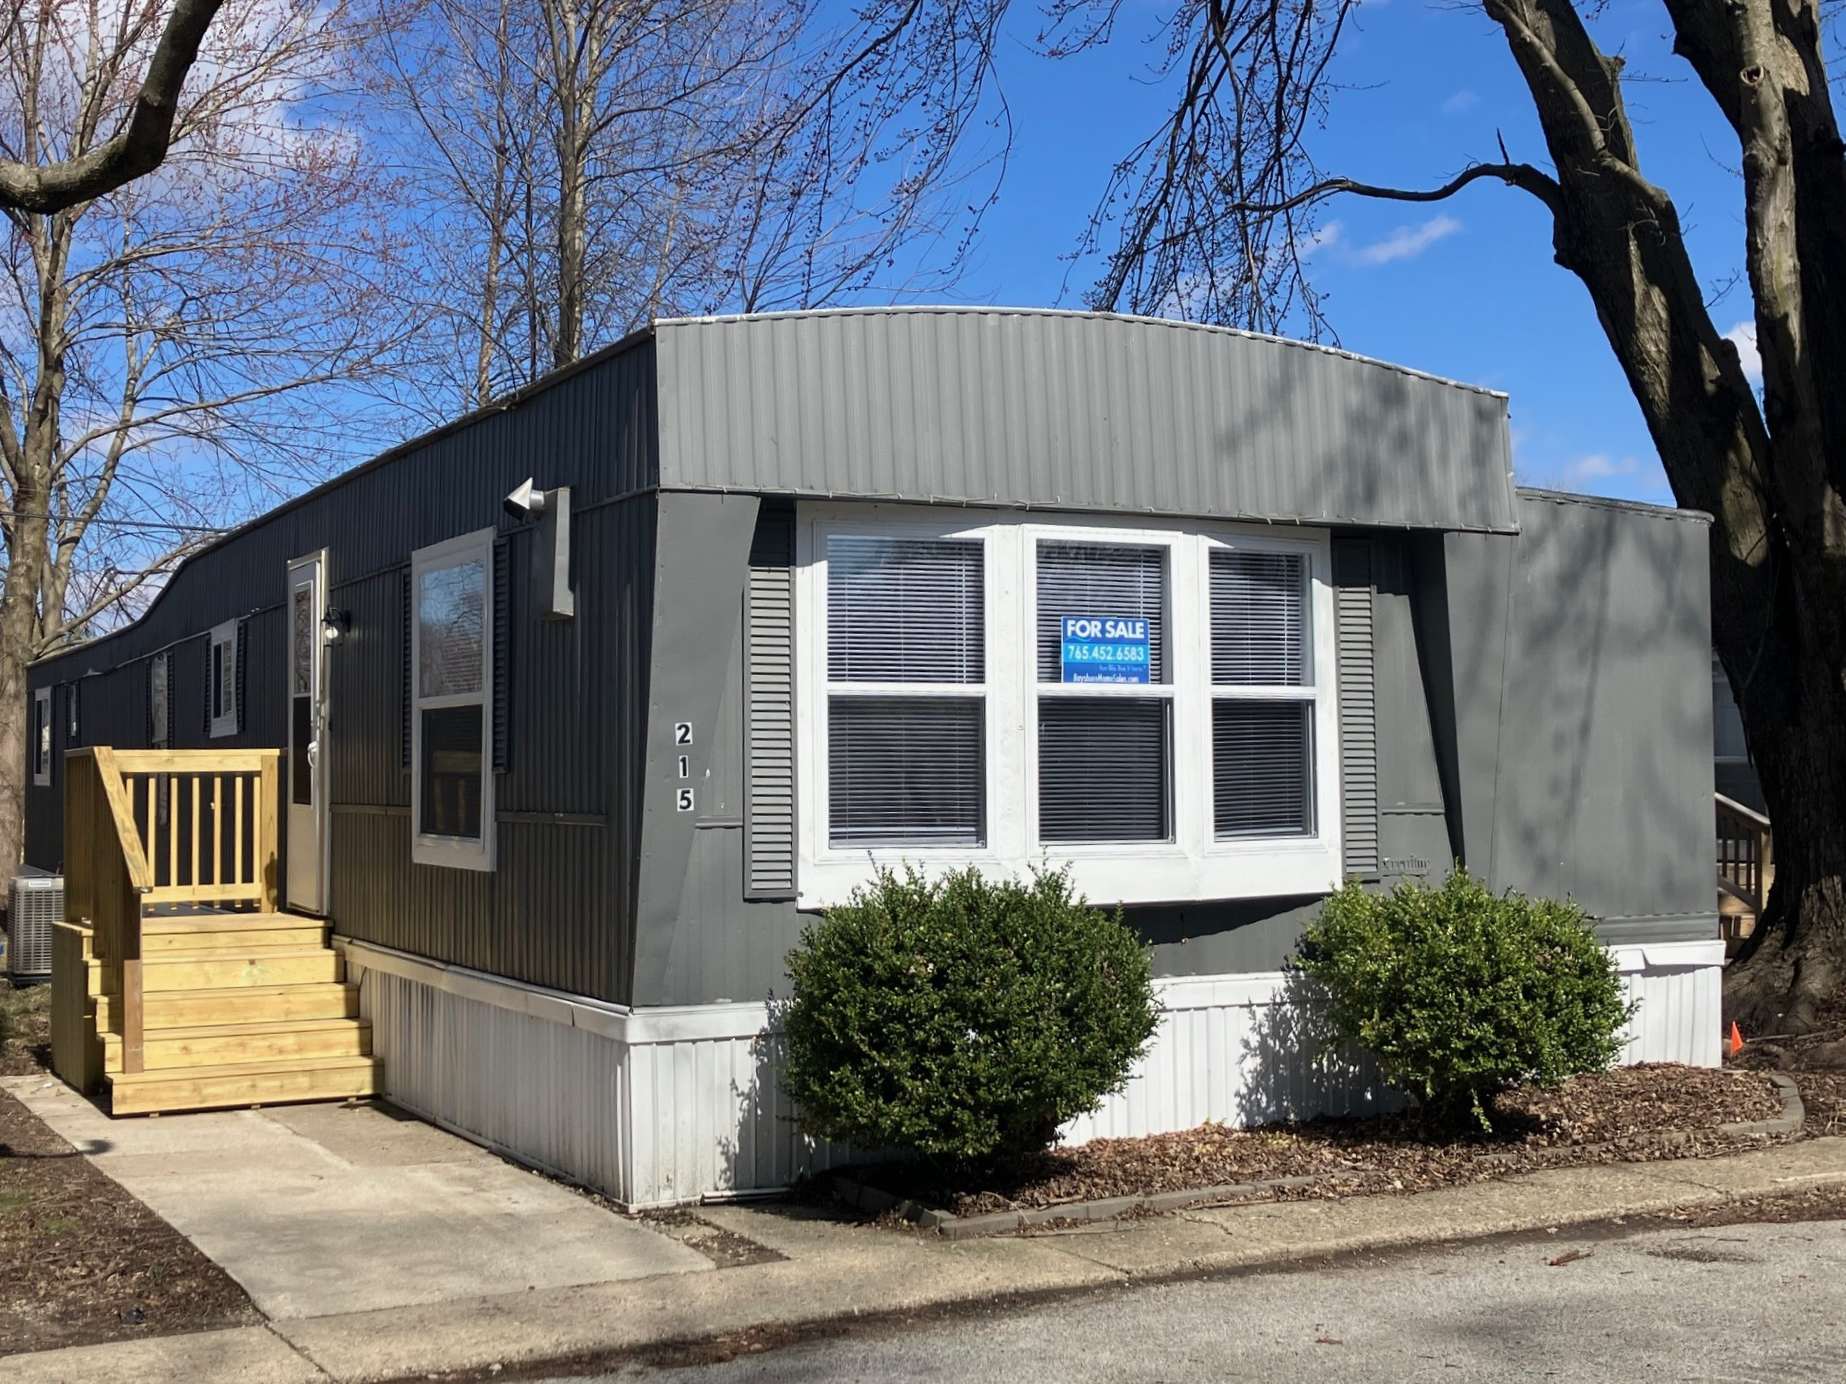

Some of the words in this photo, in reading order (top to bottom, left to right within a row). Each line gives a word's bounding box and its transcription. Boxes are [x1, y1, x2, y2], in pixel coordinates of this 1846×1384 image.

[1066, 619, 1103, 638] FOR
[1105, 620, 1145, 639] SALE
[1067, 645, 1144, 662] 765.452.6583
